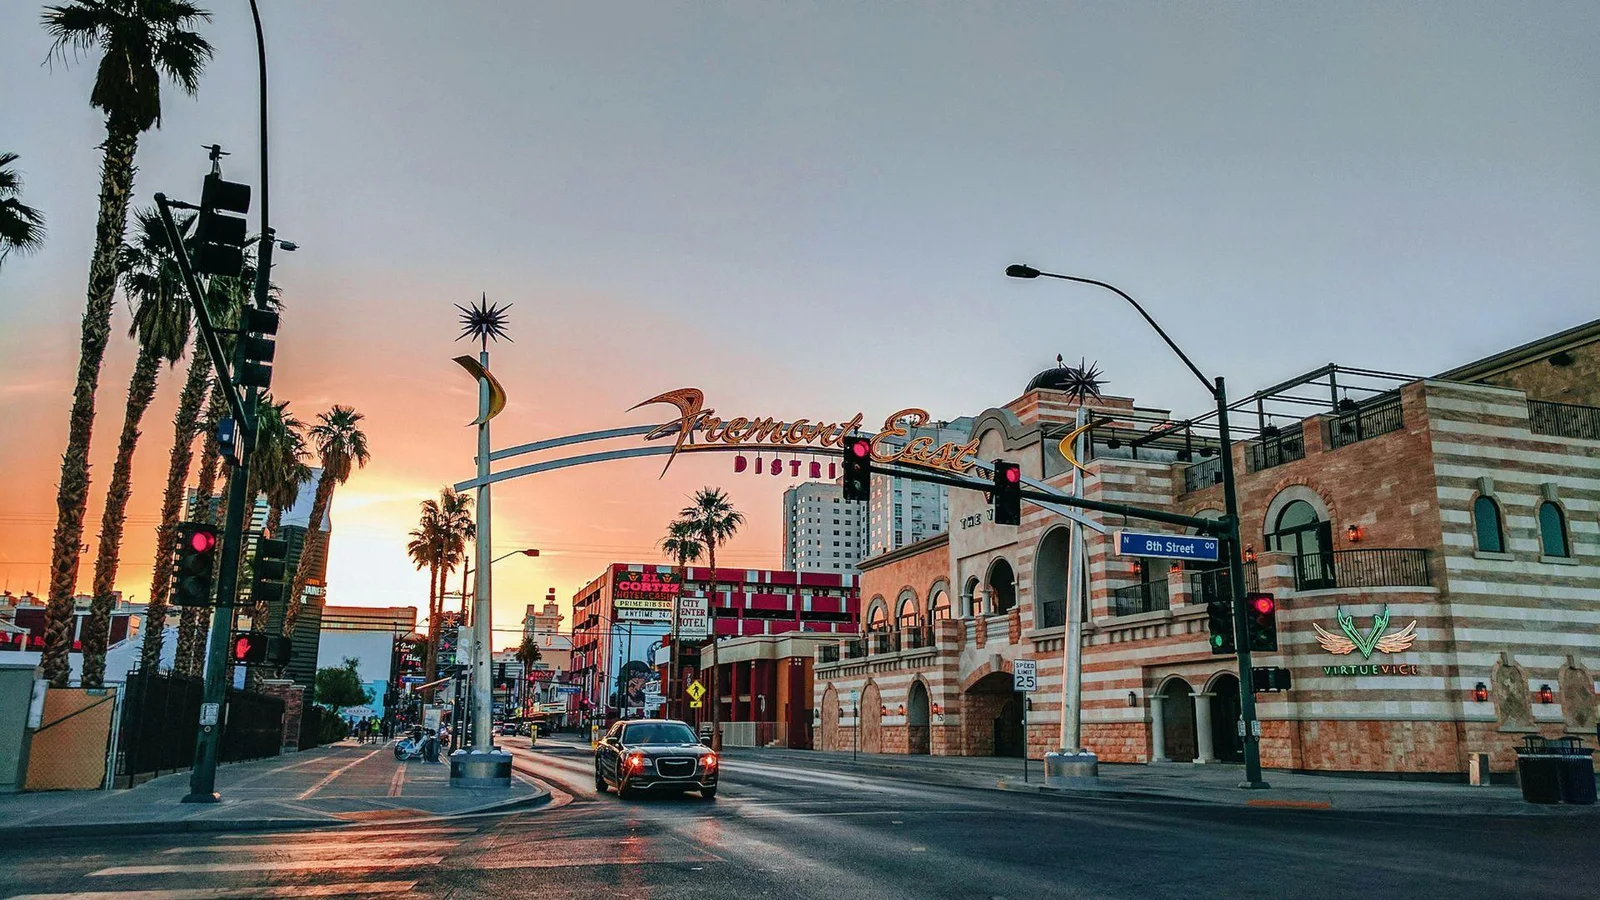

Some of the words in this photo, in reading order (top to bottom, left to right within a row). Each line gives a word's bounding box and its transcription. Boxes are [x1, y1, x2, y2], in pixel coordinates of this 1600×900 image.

[625, 387, 864, 481] Fremont
[869, 407, 980, 471] East
[733, 455, 846, 480] DISTRI
[1146, 540, 1162, 551] 8th
[1166, 542, 1194, 554] Street
[641, 573, 660, 582] EL
[619, 581, 679, 592] CORTEZ
[625, 610, 654, 618] ANYTIME
[1016, 676, 1034, 687] 25
